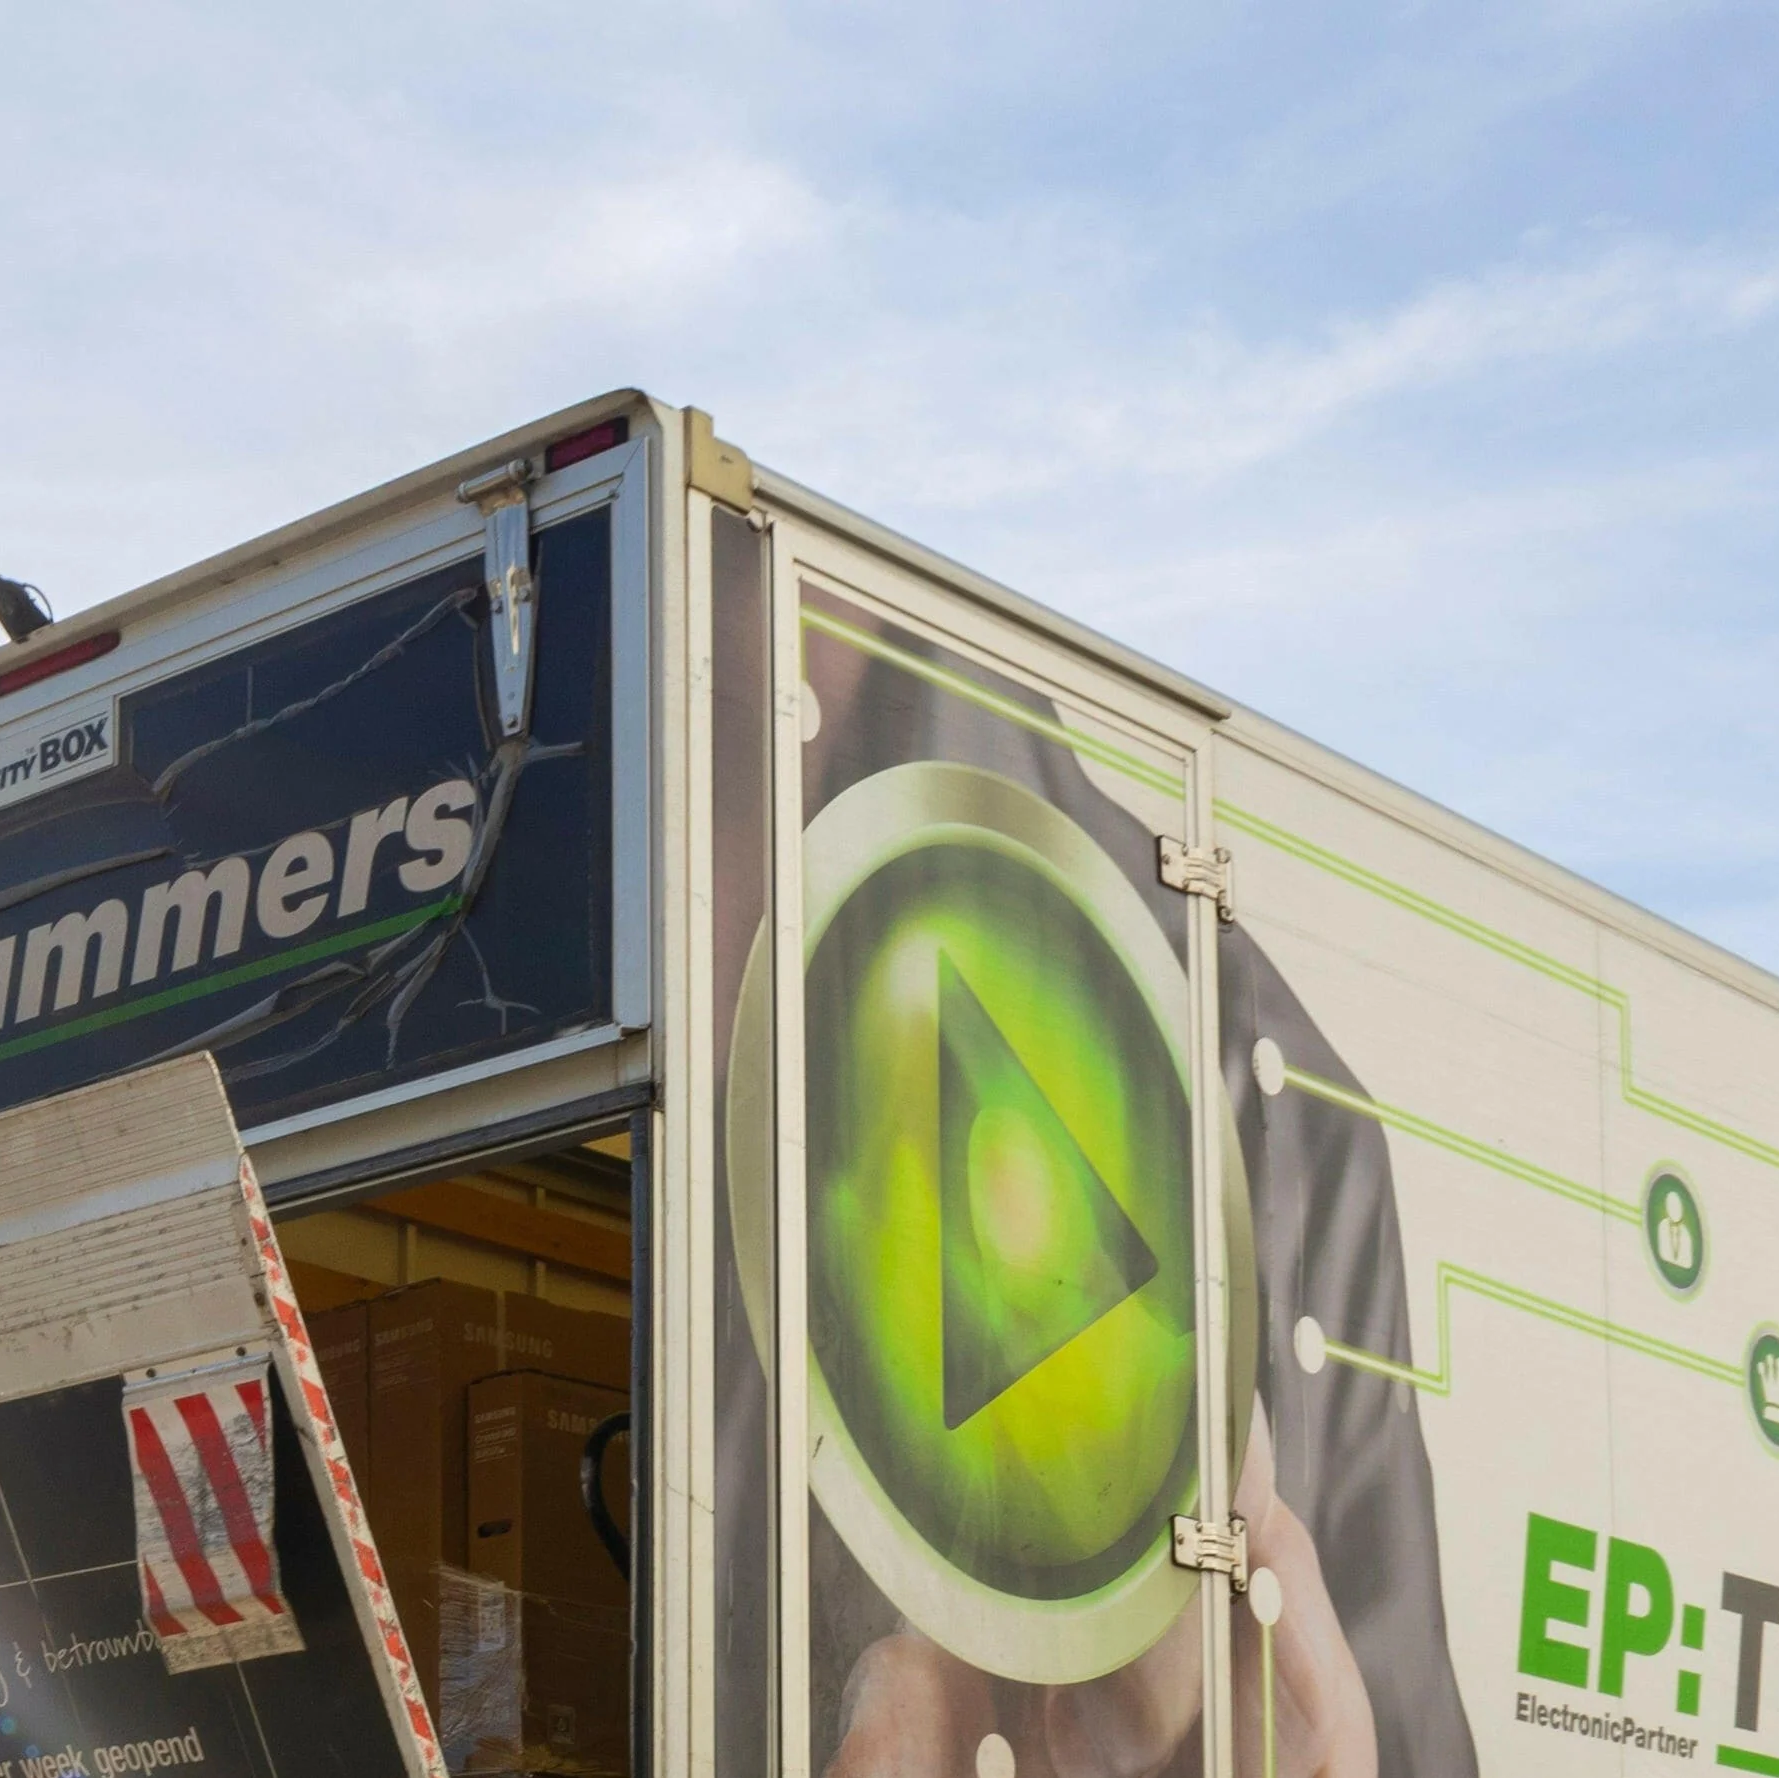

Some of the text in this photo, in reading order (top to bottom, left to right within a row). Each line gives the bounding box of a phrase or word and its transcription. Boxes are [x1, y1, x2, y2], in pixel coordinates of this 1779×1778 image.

[40, 716, 109, 774] BOX
[1517, 1511, 1706, 1717] EP:
[94, 1727, 204, 1777] geopend
[1515, 1691, 1699, 1760] ElectronicPartner
